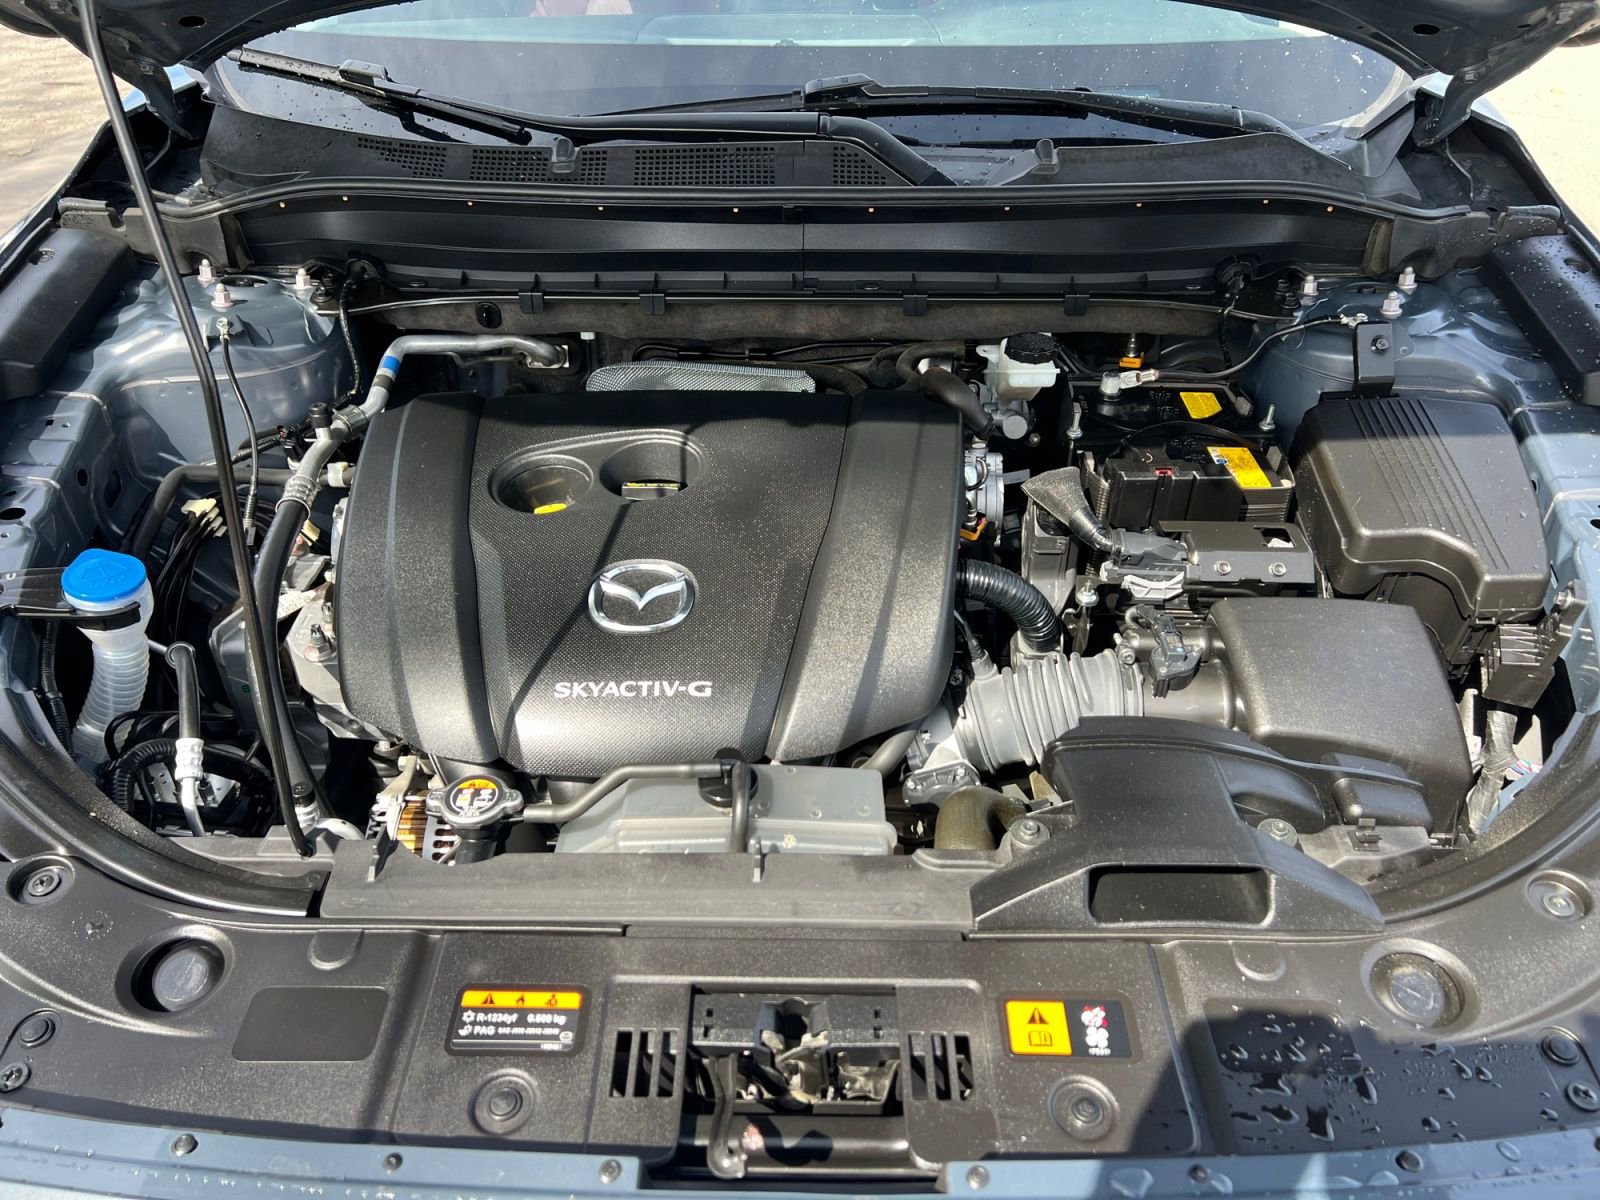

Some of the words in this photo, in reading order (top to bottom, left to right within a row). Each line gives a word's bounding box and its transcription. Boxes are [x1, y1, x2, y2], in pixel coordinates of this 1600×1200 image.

[554, 680, 713, 698] SKYACTIV-G
[476, 1012, 518, 1024] R-1234yf
[473, 1025, 496, 1036] PAG
